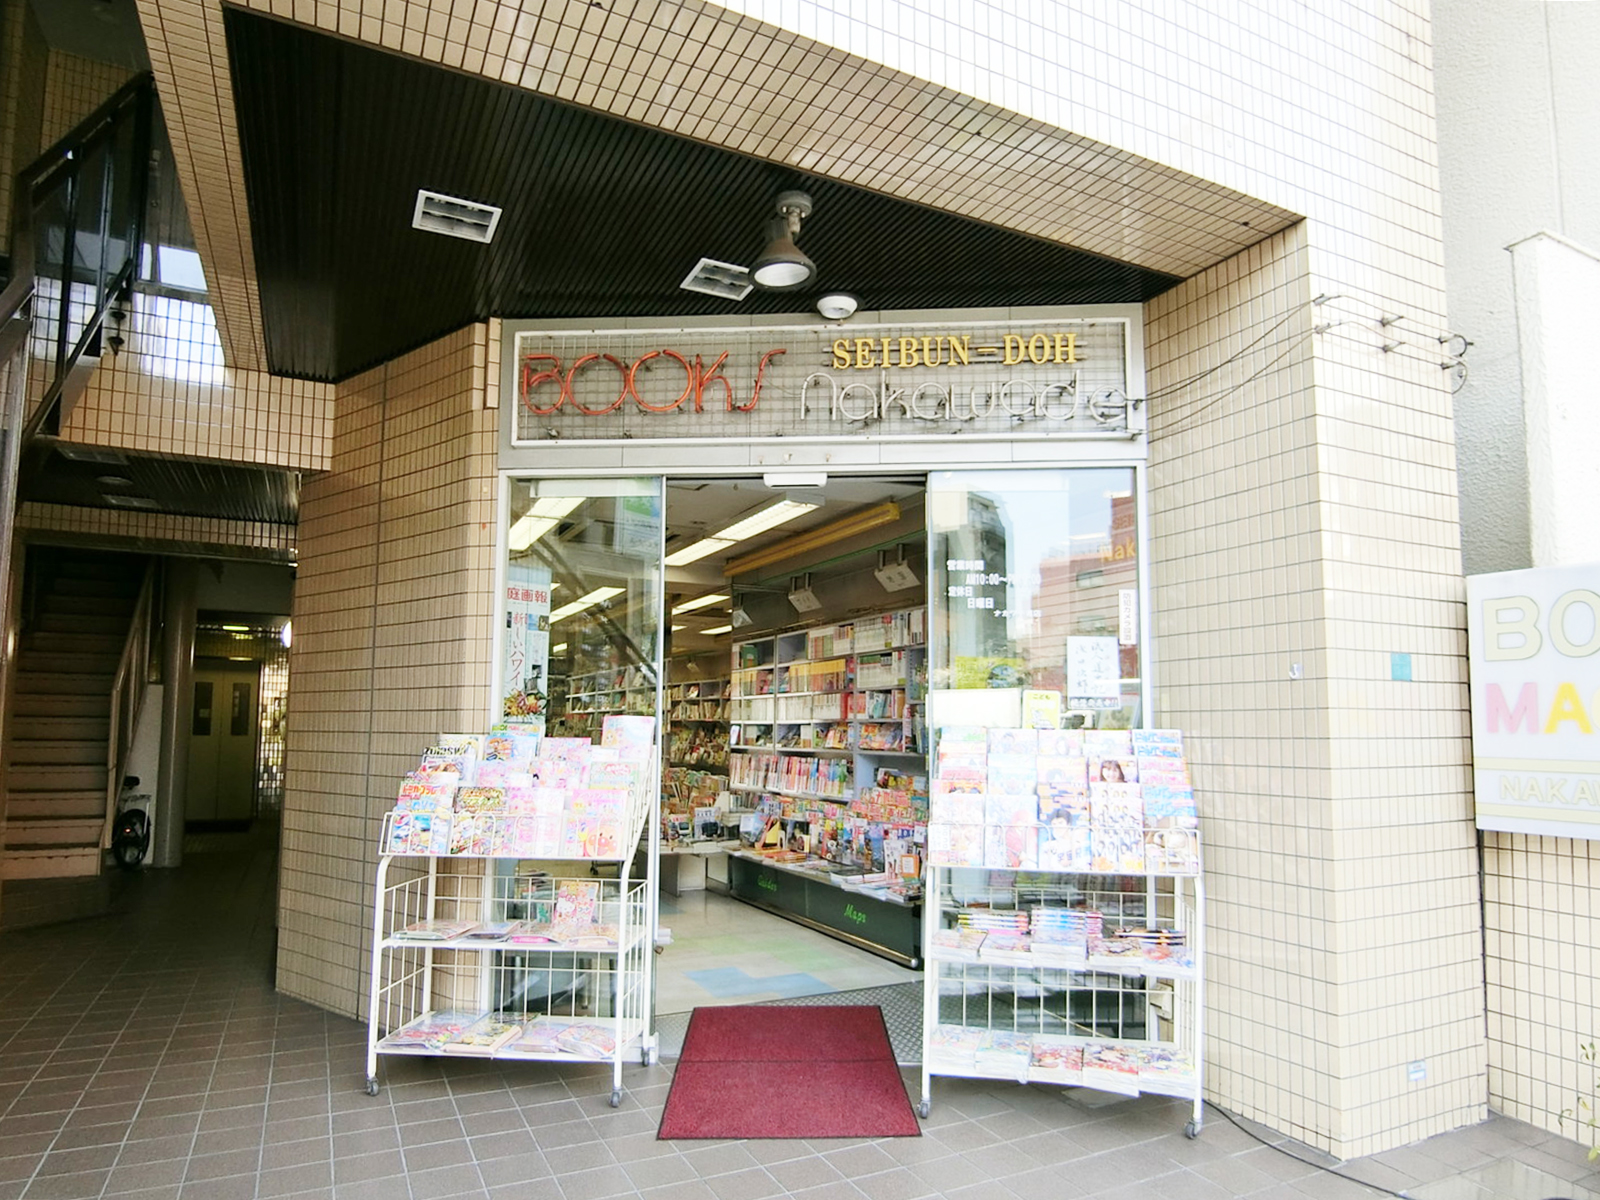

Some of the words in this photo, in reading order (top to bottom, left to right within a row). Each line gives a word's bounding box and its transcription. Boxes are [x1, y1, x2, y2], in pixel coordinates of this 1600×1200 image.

[521, 348, 787, 416] BOOKS
[947, 560, 984, 571] 営業時間
[948, 586, 973, 597] 定休日
[967, 597, 994, 609] 日曜日
[1498, 774, 1600, 806] NAKA
[843, 903, 868, 925] Maps
